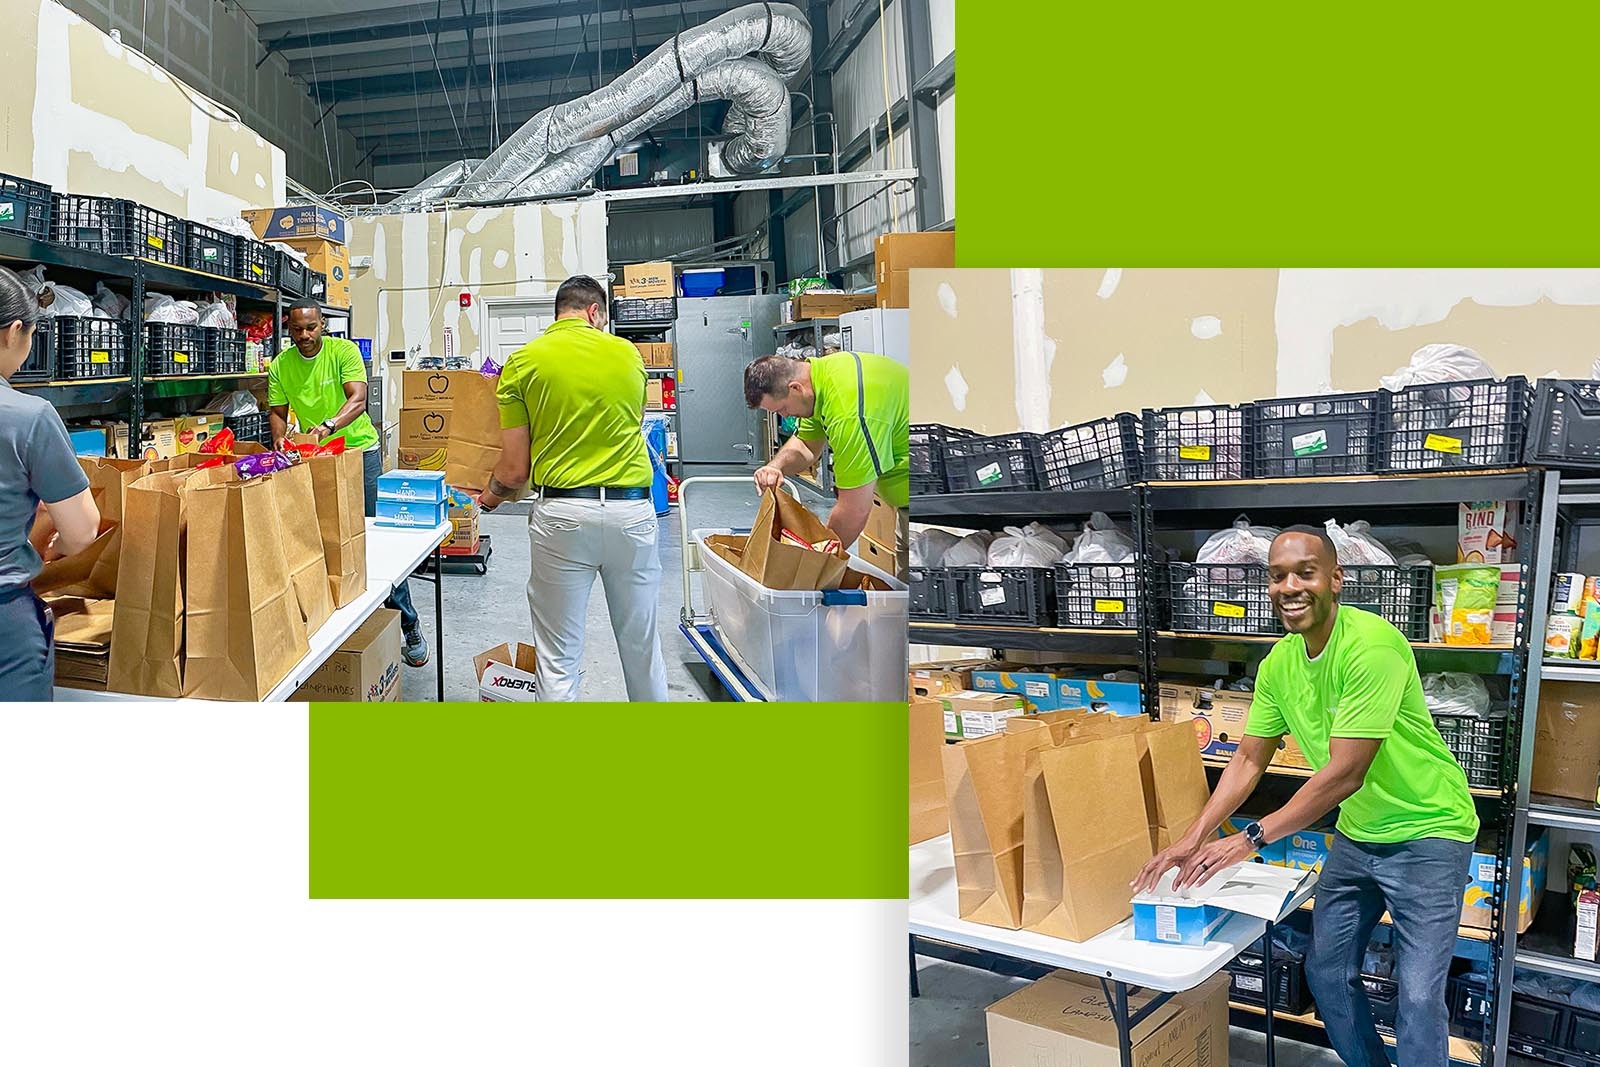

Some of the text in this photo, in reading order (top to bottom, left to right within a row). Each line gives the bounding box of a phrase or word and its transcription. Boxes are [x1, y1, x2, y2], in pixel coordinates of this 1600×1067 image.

[395, 489, 416, 497] HAND
[394, 513, 415, 521] HAND
[1466, 510, 1494, 529] RIND
[976, 676, 996, 688] One
[1061, 684, 1081, 696] One
[1292, 835, 1317, 850] One
